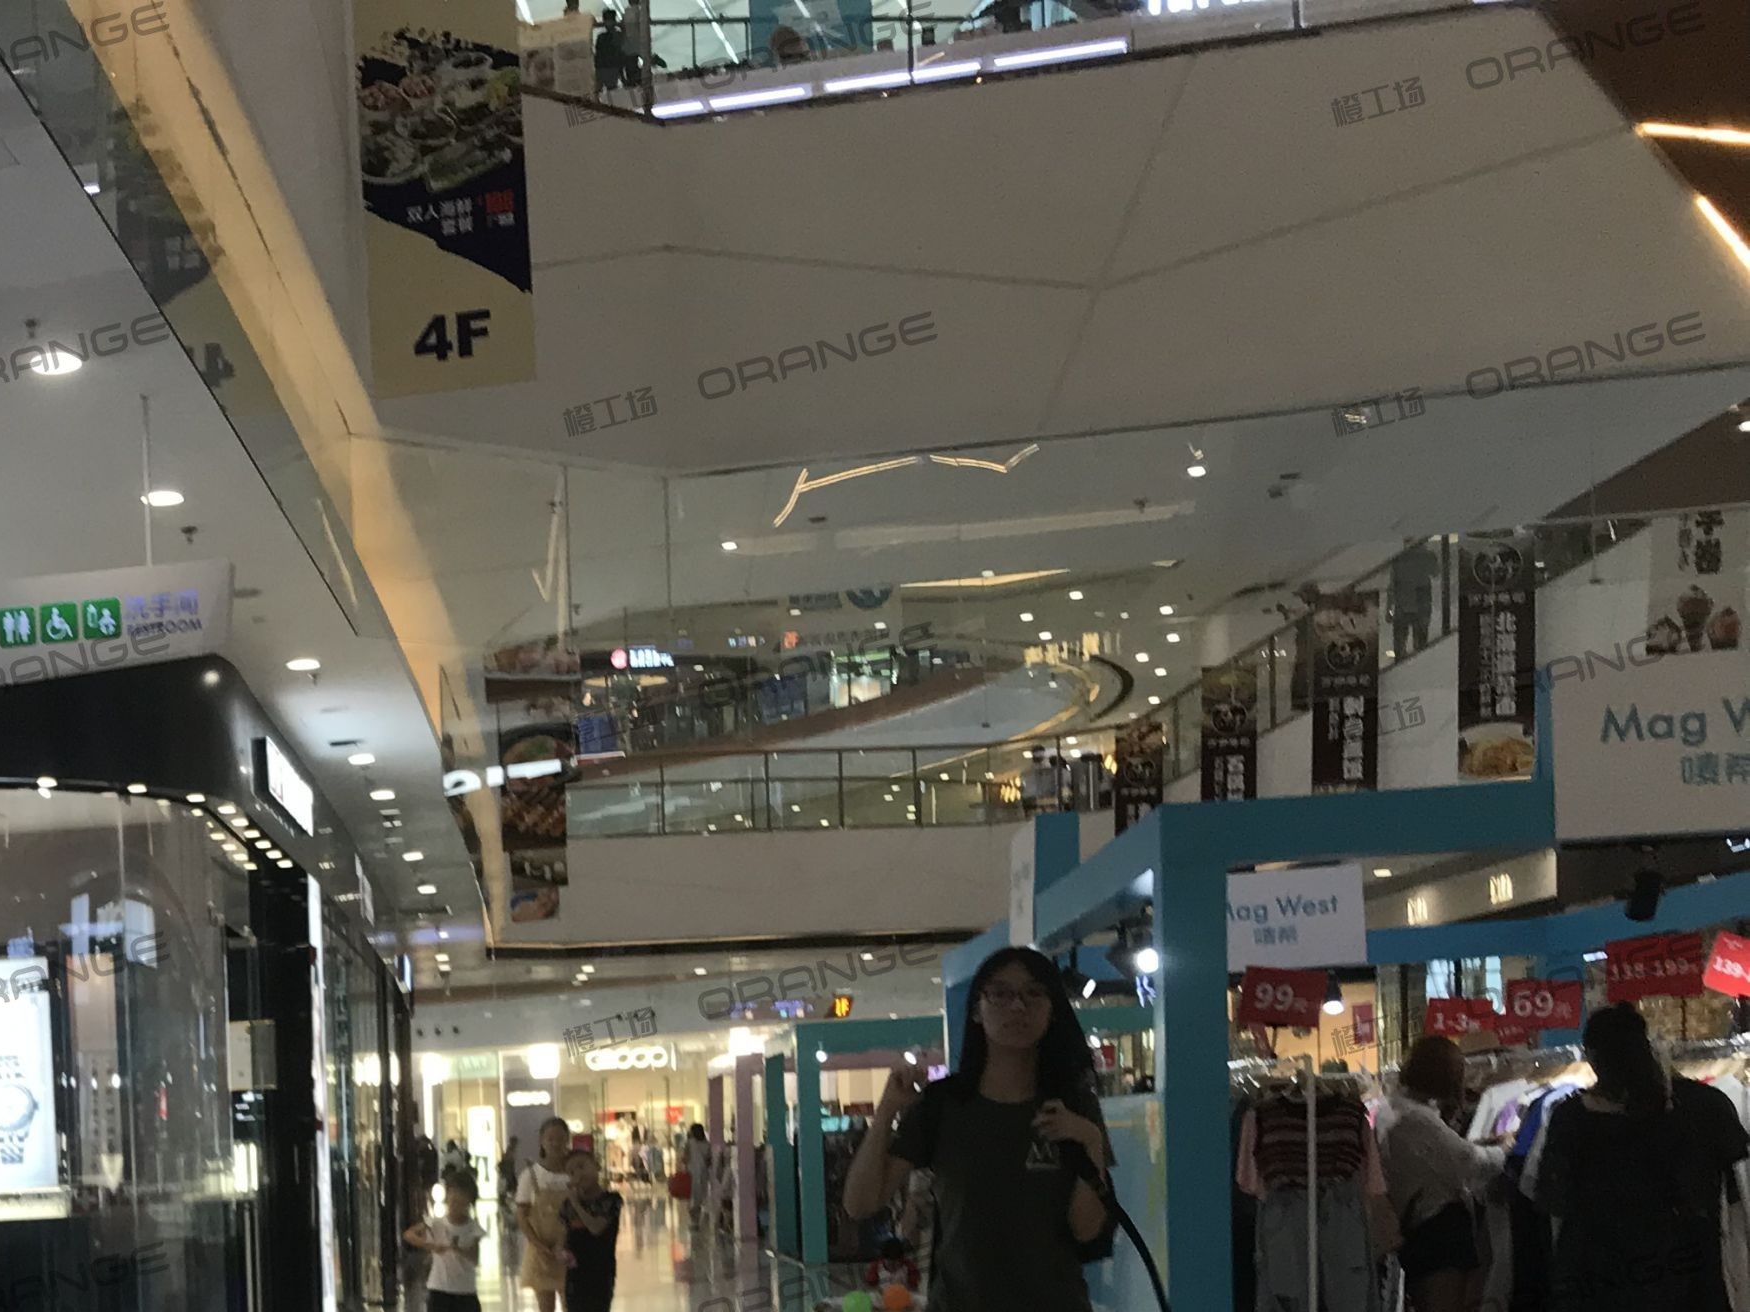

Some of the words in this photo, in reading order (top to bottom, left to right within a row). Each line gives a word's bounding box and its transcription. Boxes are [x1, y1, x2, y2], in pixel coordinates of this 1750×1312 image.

[414, 309, 491, 361] 4F
[1601, 703, 1707, 747] Mag
[1276, 895, 1338, 917] West
